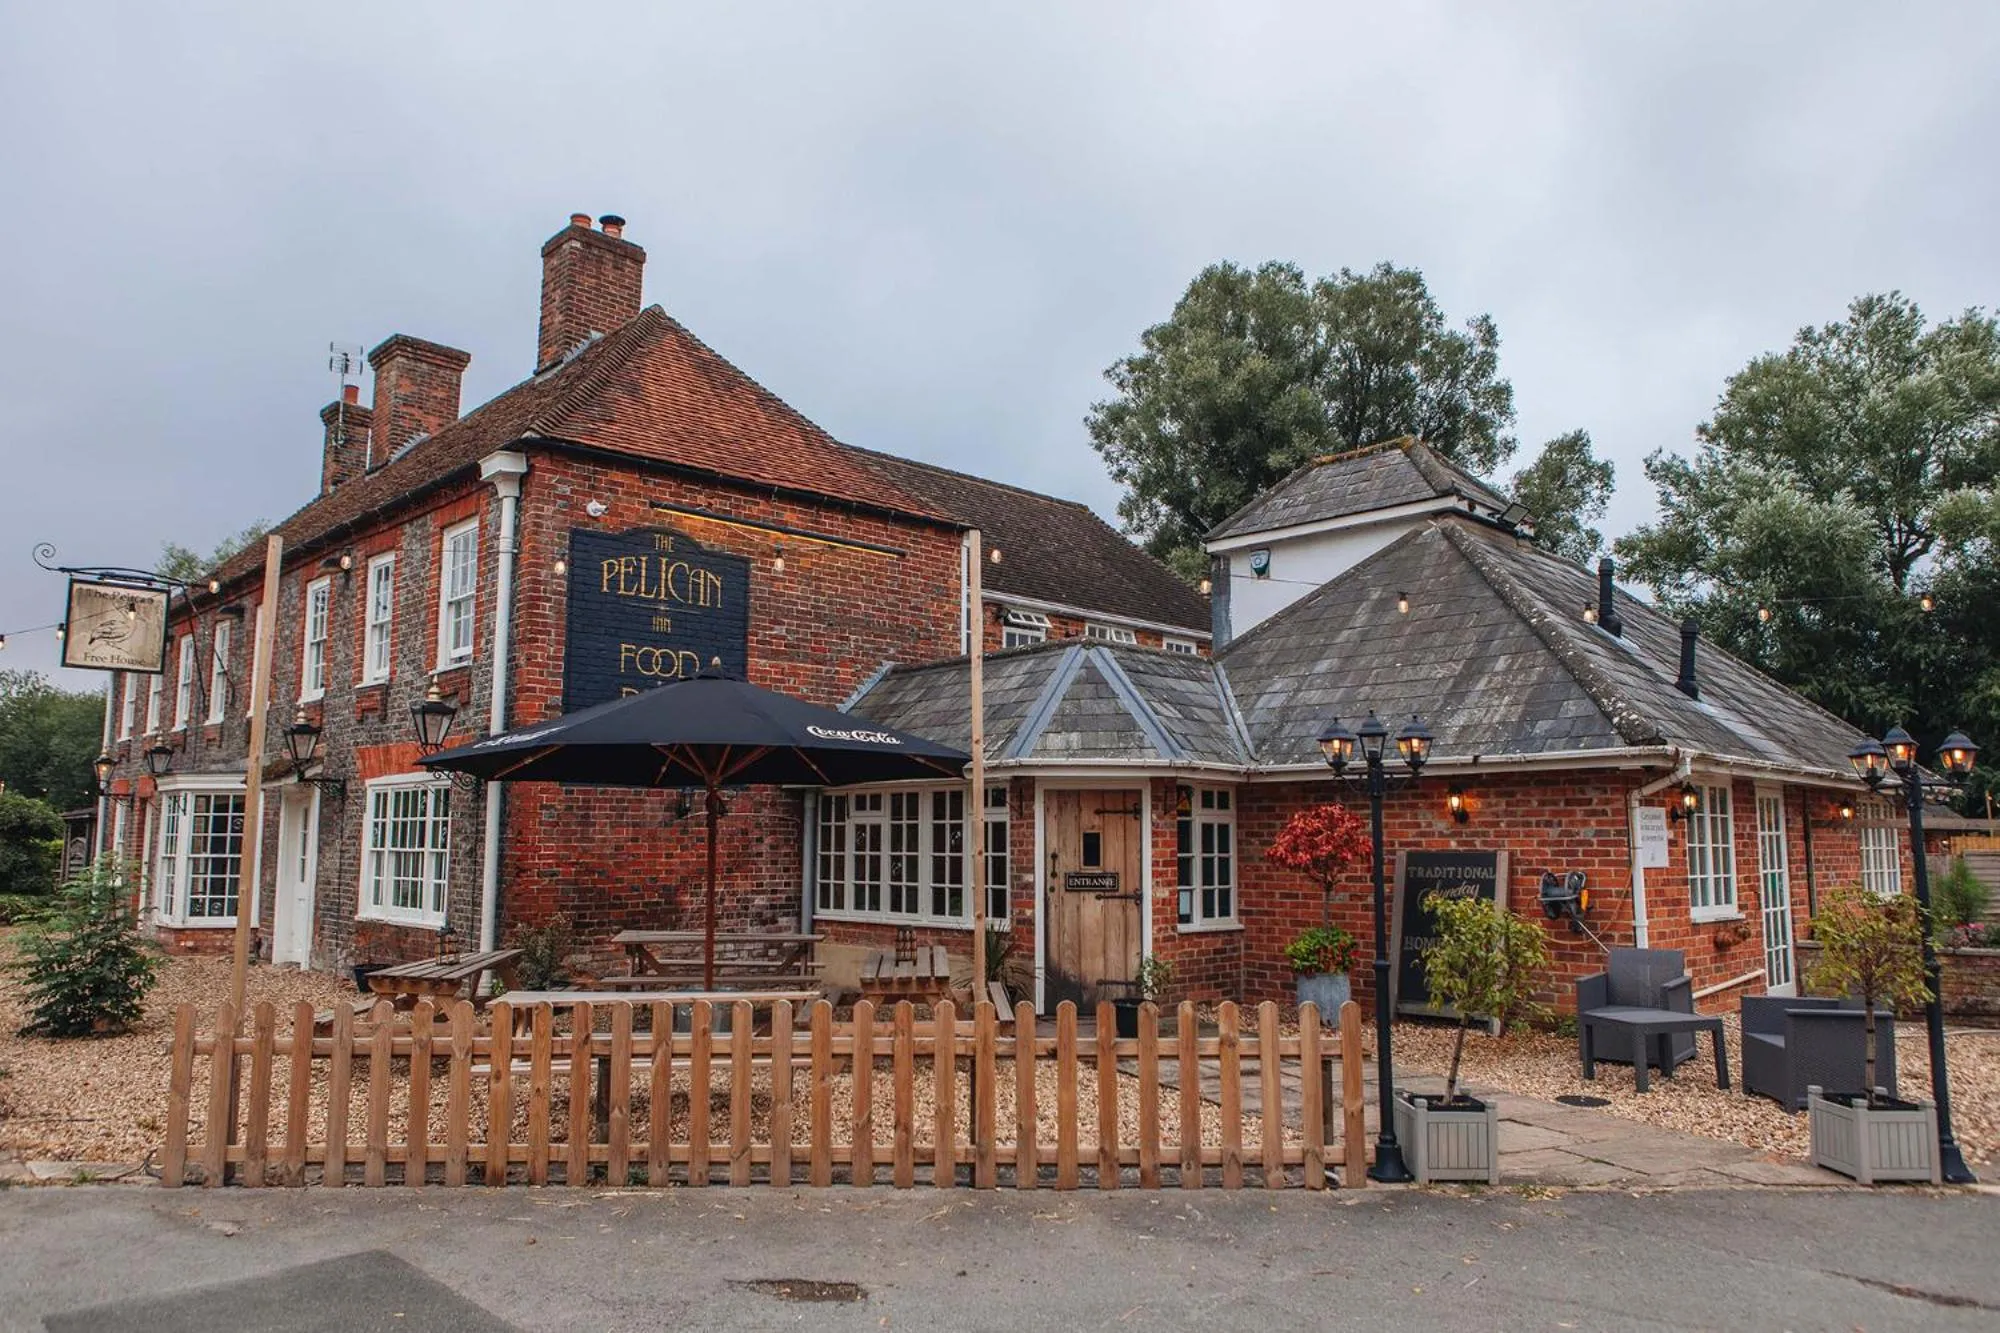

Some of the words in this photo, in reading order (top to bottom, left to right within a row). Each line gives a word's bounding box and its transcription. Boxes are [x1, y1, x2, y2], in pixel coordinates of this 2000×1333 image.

[654, 534, 675, 553] THE
[601, 556, 722, 608] PELICAN
[87, 588, 109, 600] The
[83, 652, 108, 663] Free
[110, 654, 146, 666] House
[620, 643, 699, 678] FOOD
[1408, 866, 1497, 879] TRADITIONAL
[1068, 877, 1116, 887] ENTRANCE
